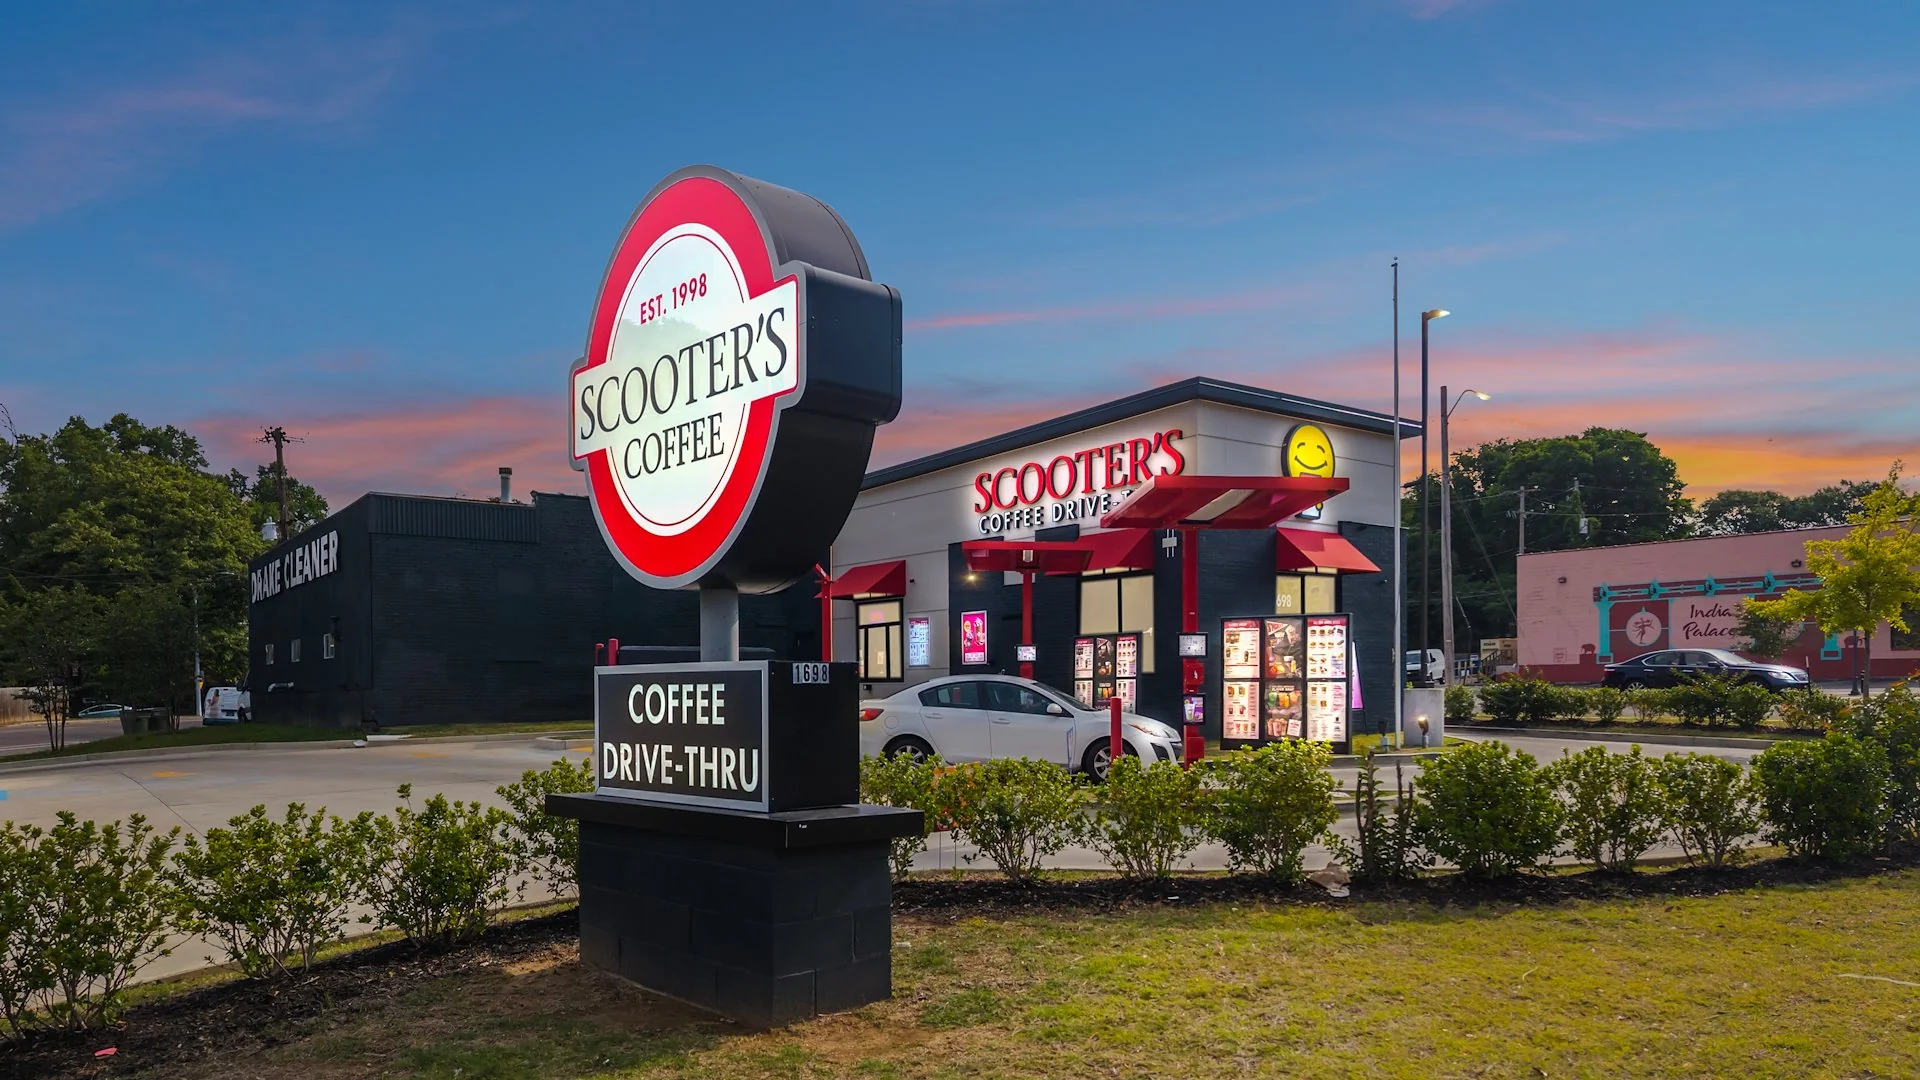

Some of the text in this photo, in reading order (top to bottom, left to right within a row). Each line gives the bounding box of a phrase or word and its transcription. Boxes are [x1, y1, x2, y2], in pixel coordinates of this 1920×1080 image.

[641, 273, 707, 325] EST. 1998
[580, 307, 788, 440] SCOOTER'S
[624, 412, 725, 480] COFFEE
[974, 429, 1185, 513] SCOOTER'S
[978, 505, 1044, 534] COFFEE
[251, 530, 339, 604] DRAKE CLEANER
[1690, 603, 1732, 618] India
[795, 663, 828, 682] 1698
[628, 683, 725, 725] COFFEE
[603, 742, 759, 793] DRIVE-THRU
